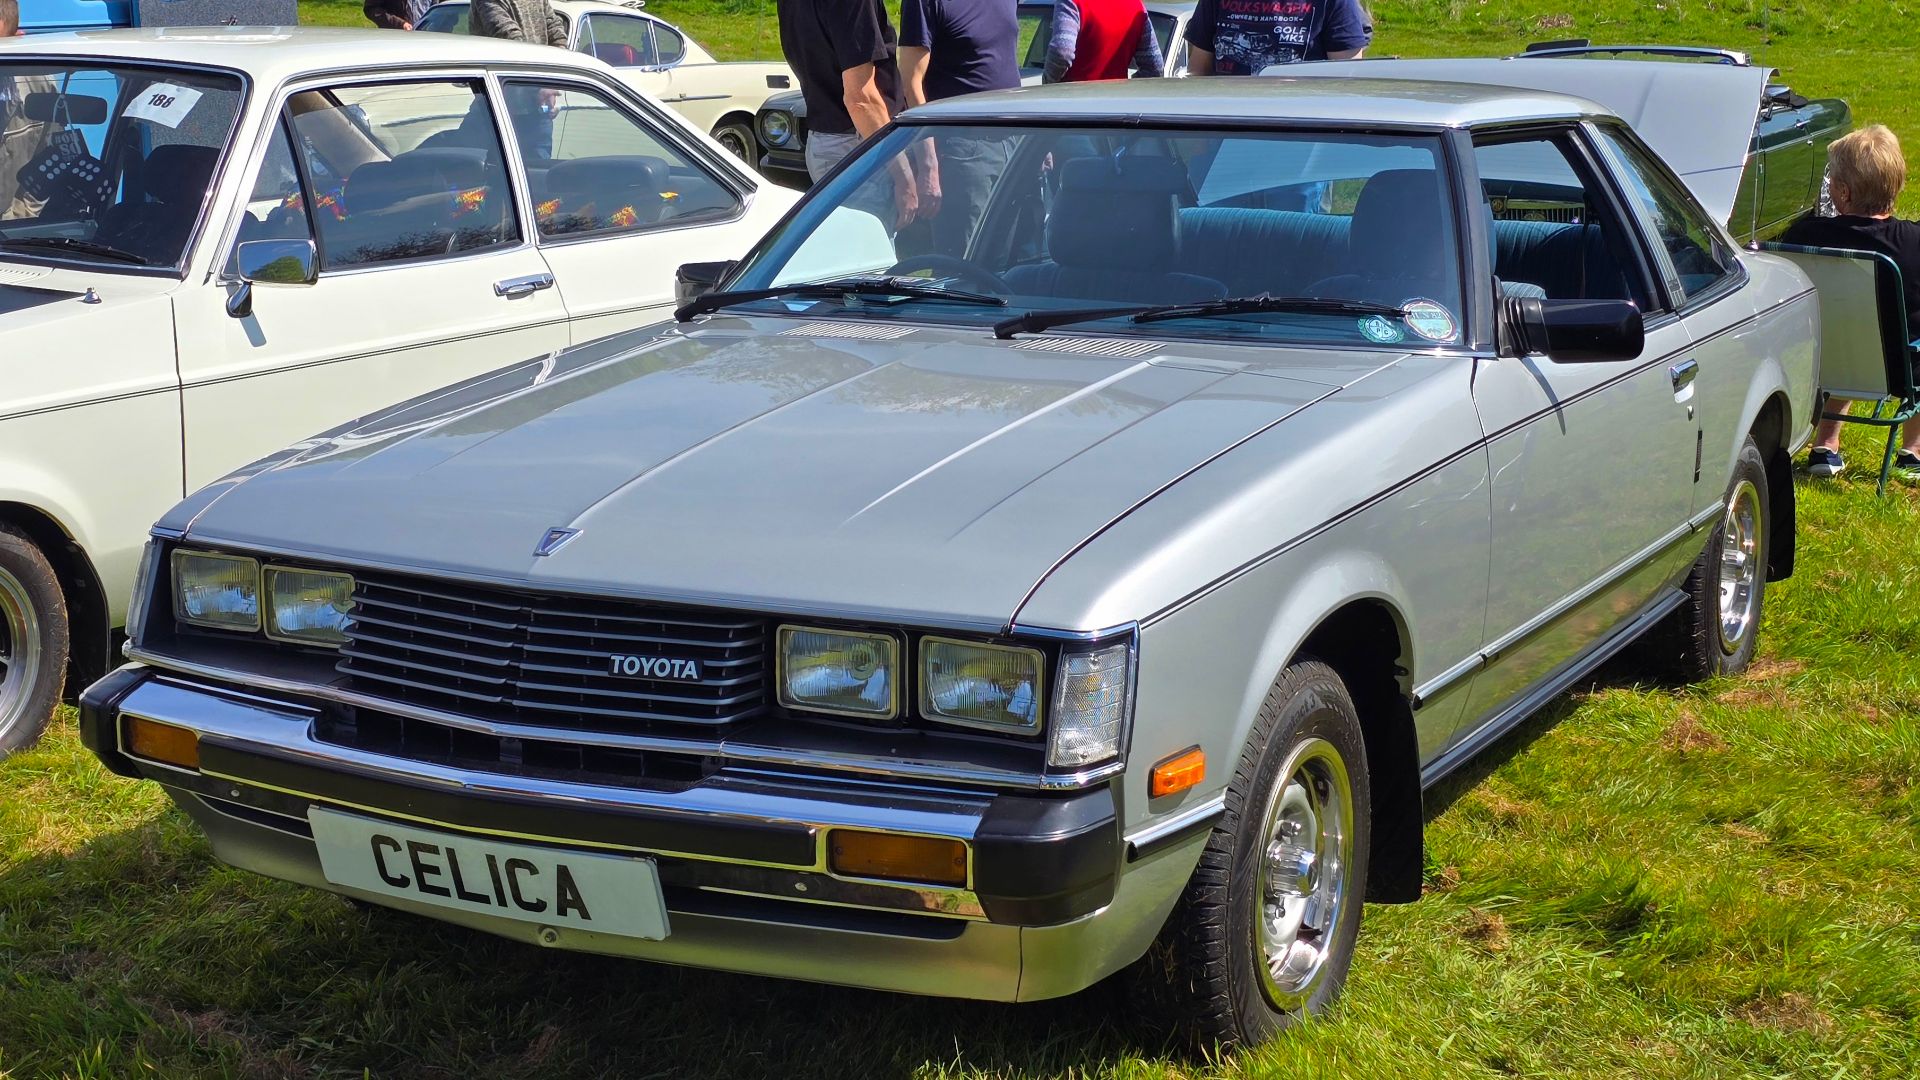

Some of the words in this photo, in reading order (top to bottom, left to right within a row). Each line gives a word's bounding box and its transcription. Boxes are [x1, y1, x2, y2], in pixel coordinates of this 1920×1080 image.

[1221, 0, 1312, 13] VOLKSWAGEN
[1274, 26, 1307, 34] GOLF
[1279, 34, 1304, 42] MK1
[148, 94, 175, 108] 188
[610, 655, 698, 679] TOYOTA
[370, 833, 592, 921] CELICA
